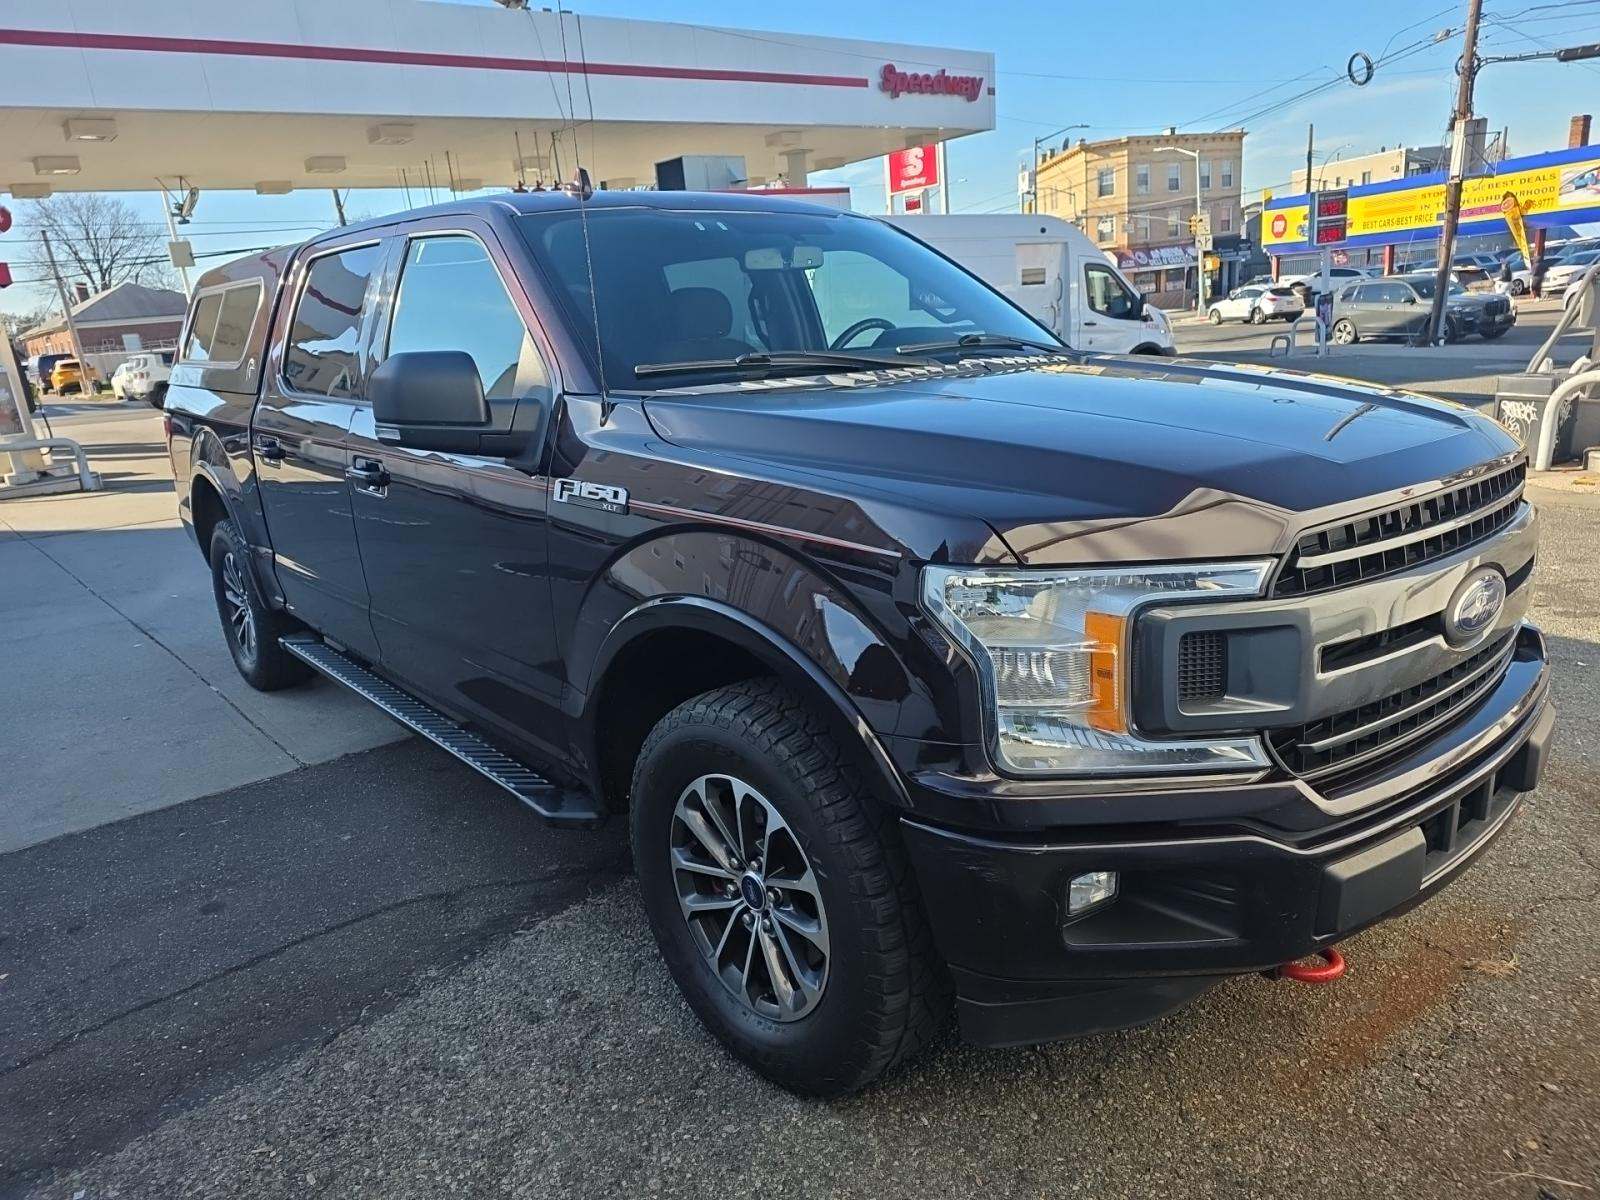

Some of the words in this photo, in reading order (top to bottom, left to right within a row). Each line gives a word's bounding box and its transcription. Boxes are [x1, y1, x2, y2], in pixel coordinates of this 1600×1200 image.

[880, 64, 984, 102] Speedway
[1488, 178, 1515, 190] BEST
[1519, 173, 1557, 184] DEALS
[1362, 220, 1377, 230] BEST
[1414, 213, 1433, 223] PRICE
[601, 503, 617, 512] XLT
